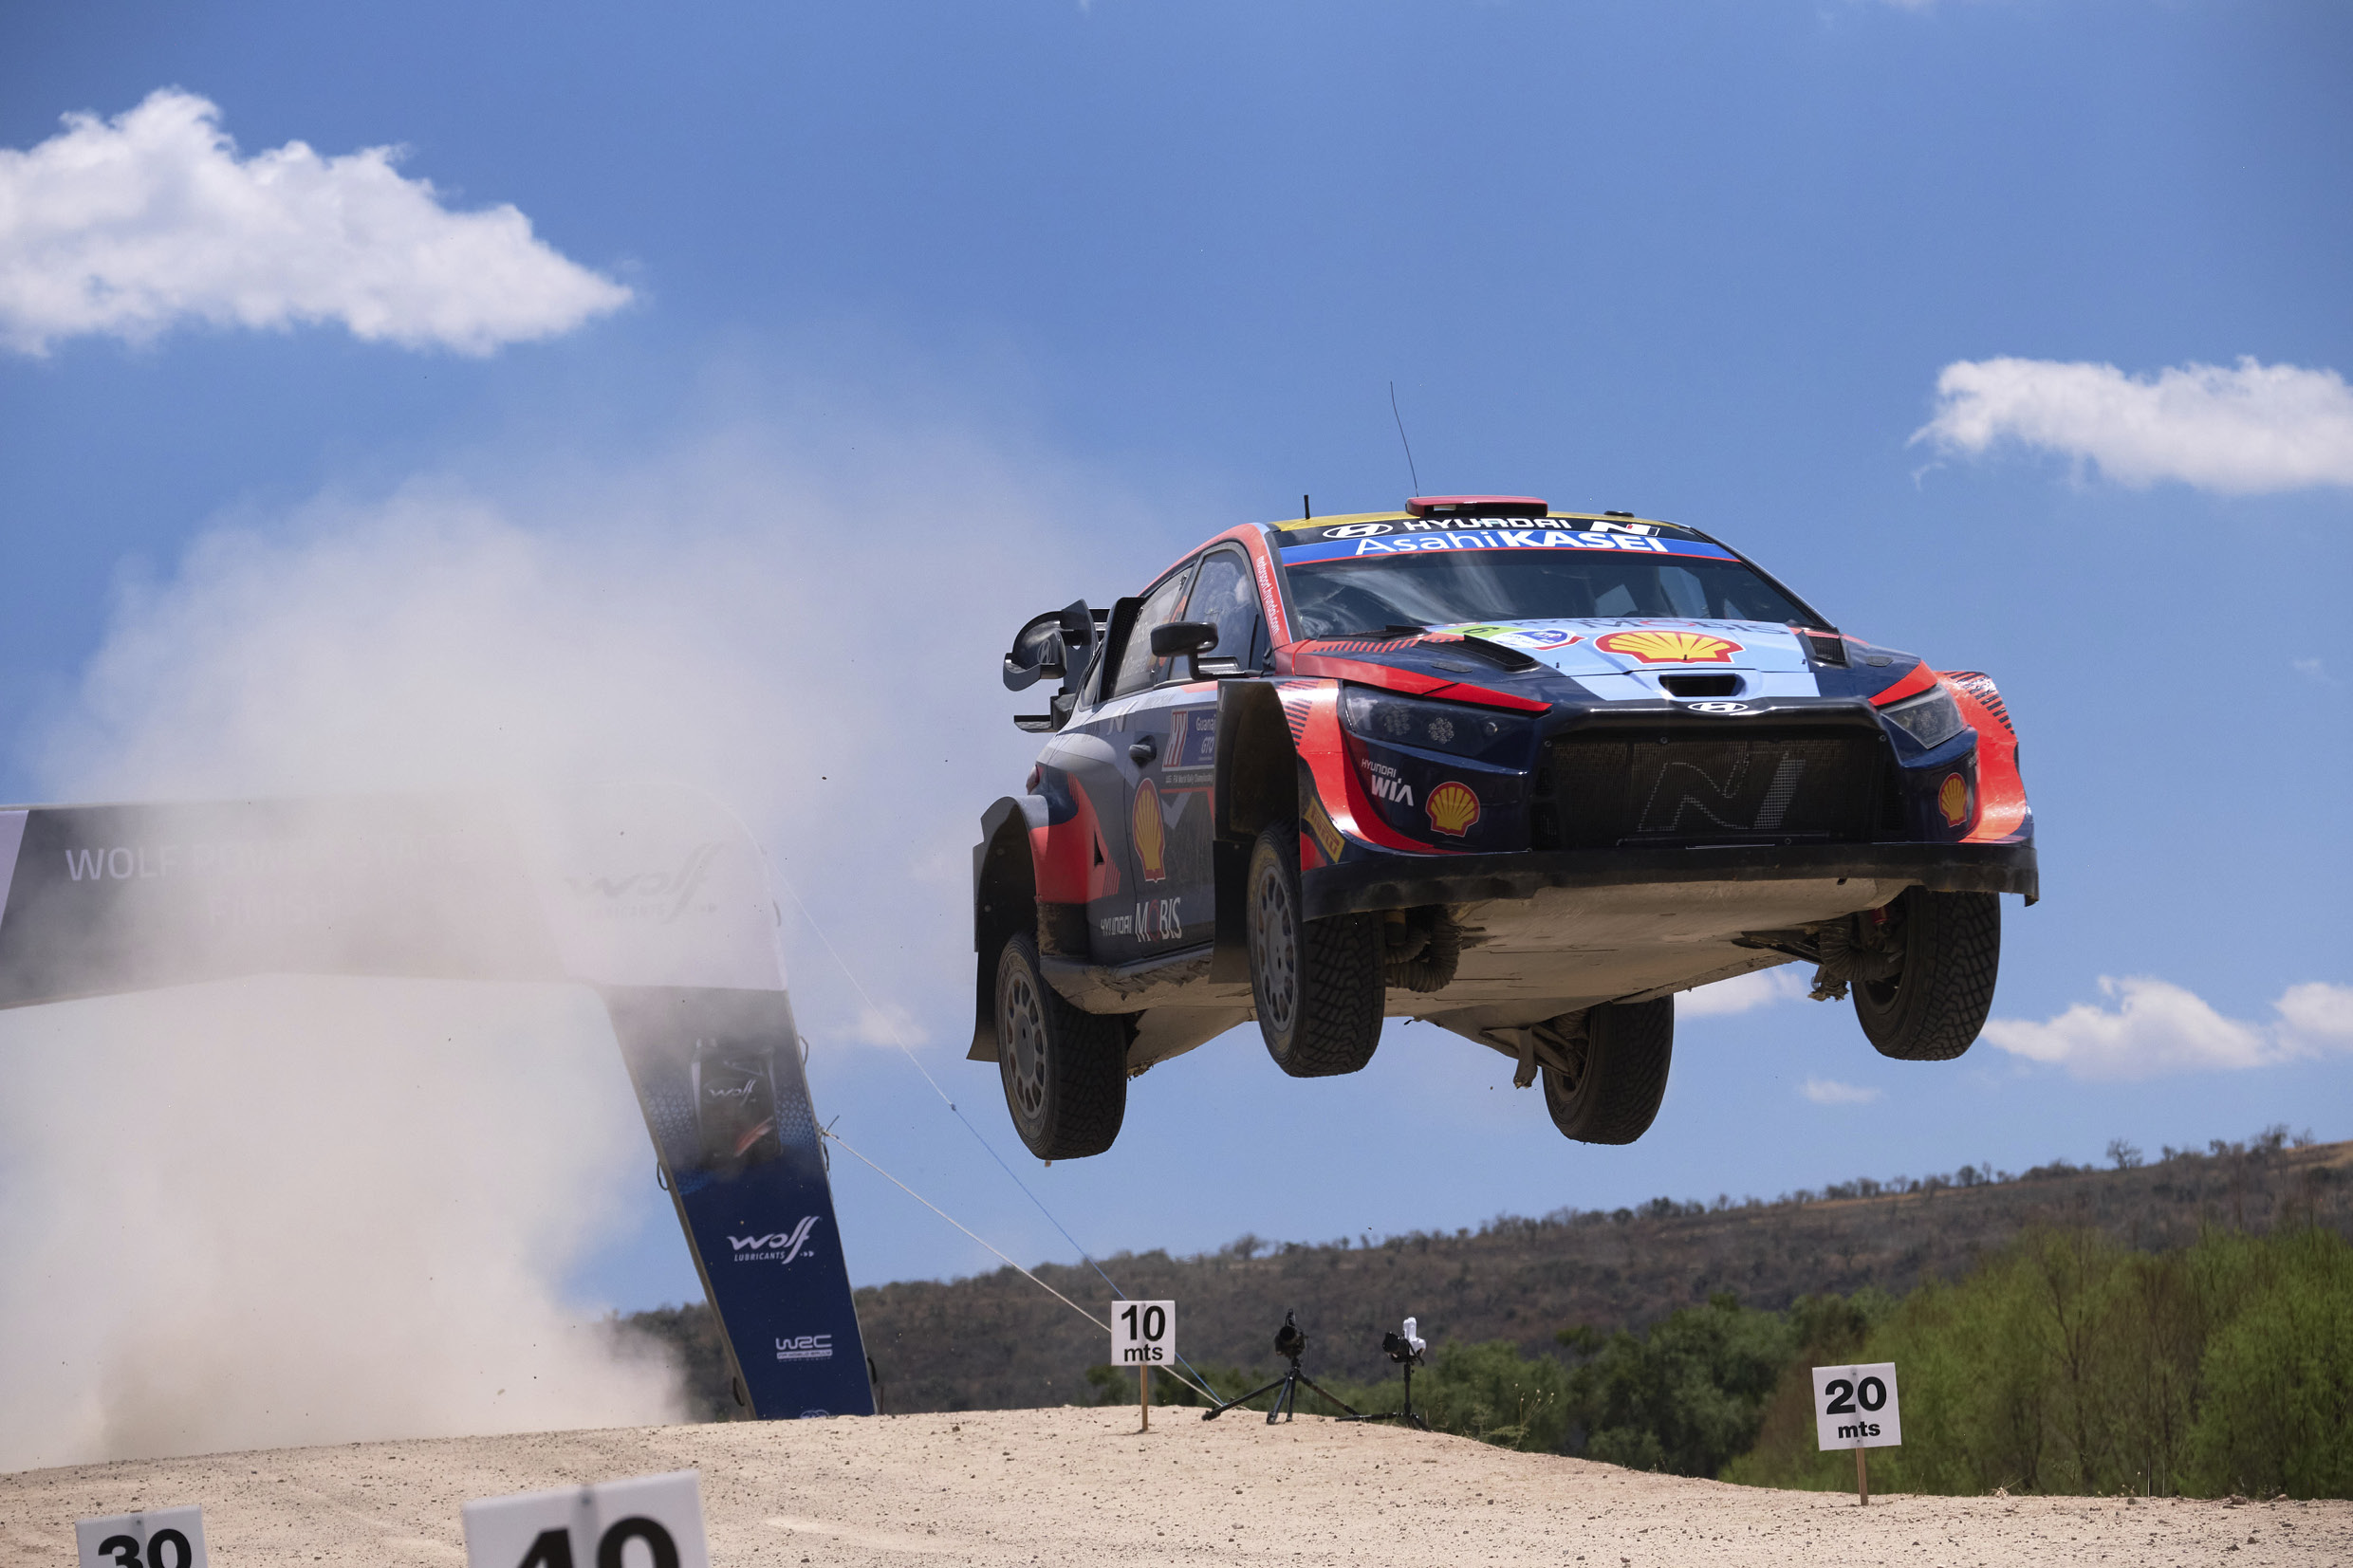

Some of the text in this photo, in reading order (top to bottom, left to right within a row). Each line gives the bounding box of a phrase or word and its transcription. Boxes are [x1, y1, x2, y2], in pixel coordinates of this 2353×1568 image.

[1403, 518, 1572, 532] HYUNDAI
[1255, 555, 1281, 636] motorsport.hyundai.com
[1362, 758, 1397, 778] HYUNDAI
[1311, 804, 1341, 856] PIRELLI
[65, 844, 180, 881] WOLF
[1101, 896, 1182, 943] HYUNDAI MOBIS
[727, 1215, 820, 1264] wolf
[733, 1250, 786, 1263] LUBRICANTS
[1121, 1304, 1165, 1341] 10
[775, 1334, 832, 1351] WRC
[1124, 1343, 1163, 1362] mts
[1825, 1376, 1886, 1414] 20
[1838, 1421, 1881, 1439] mts
[98, 1528, 192, 1568] 30
